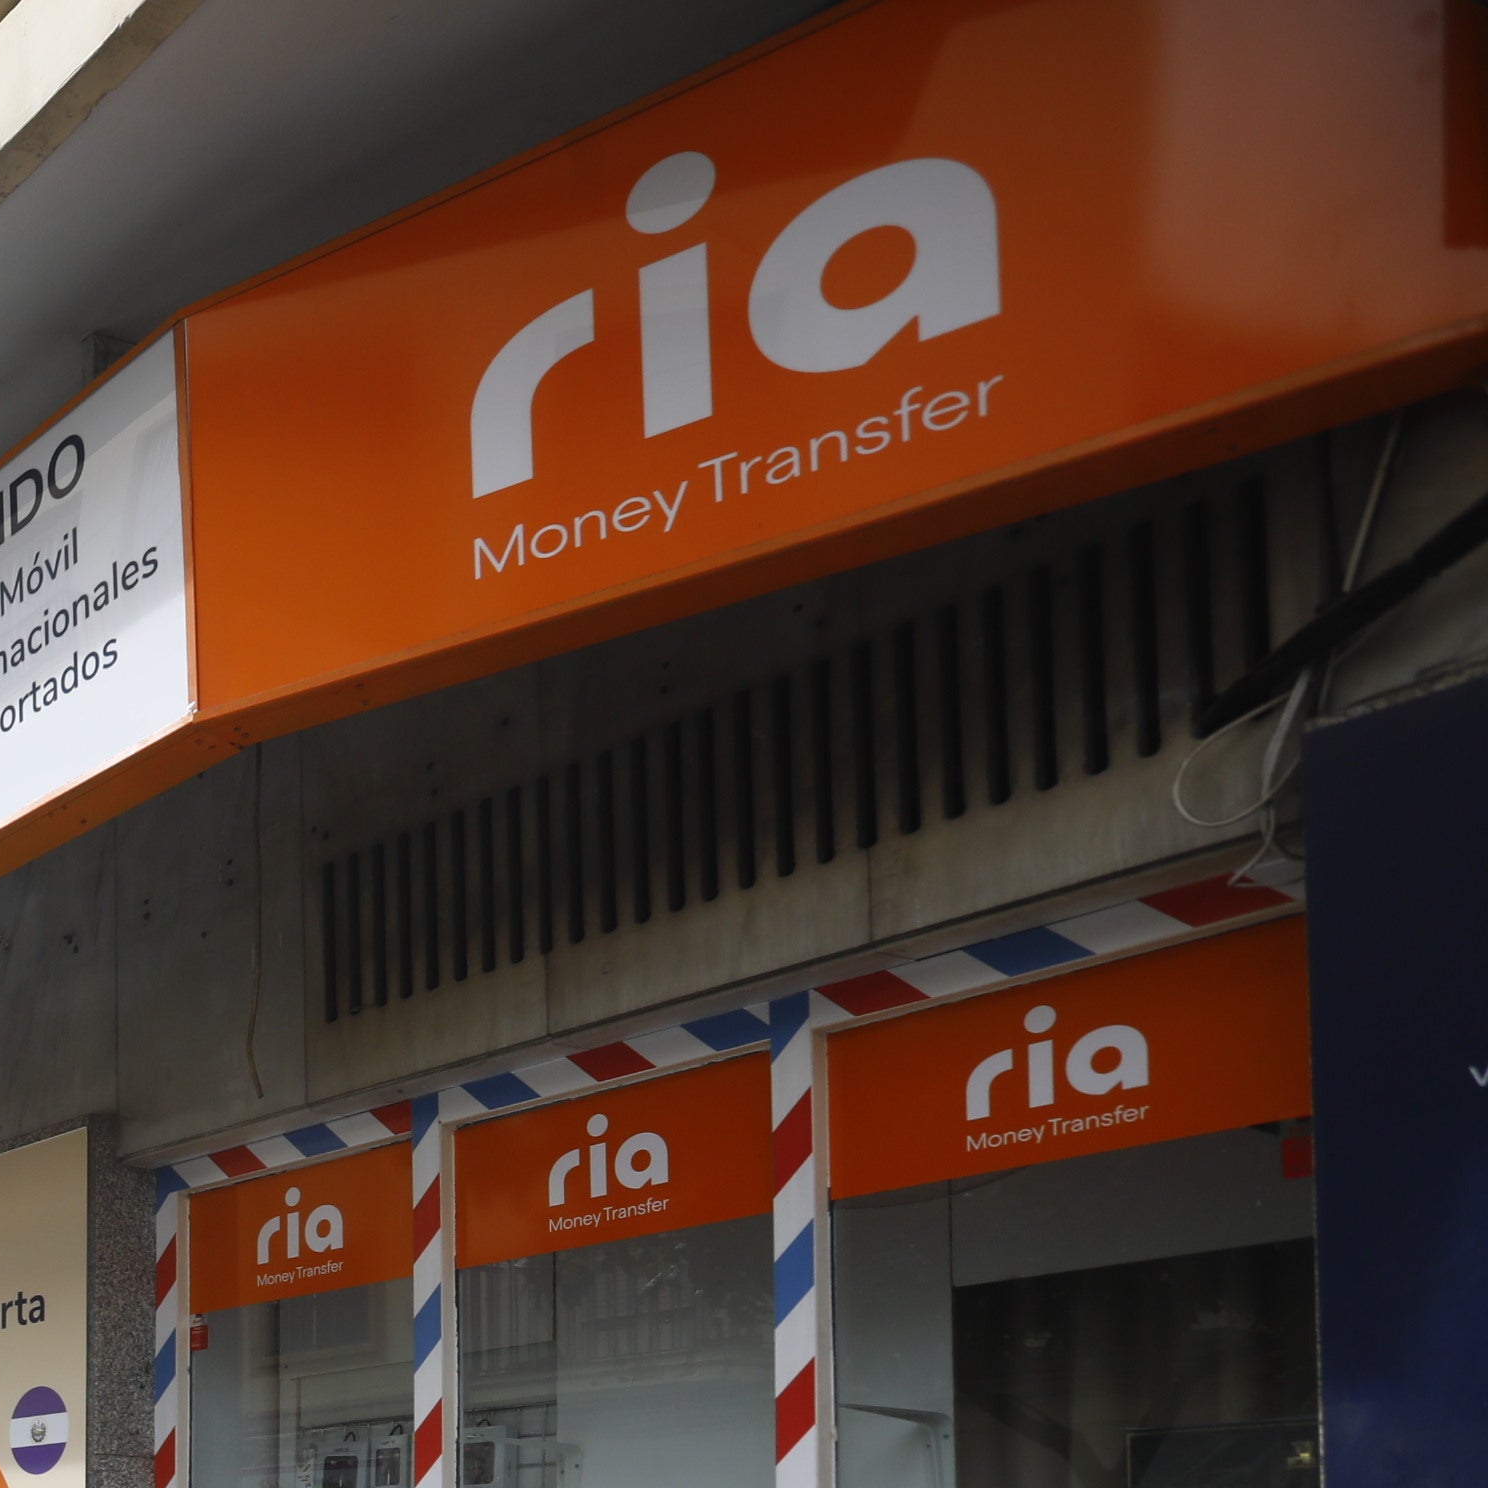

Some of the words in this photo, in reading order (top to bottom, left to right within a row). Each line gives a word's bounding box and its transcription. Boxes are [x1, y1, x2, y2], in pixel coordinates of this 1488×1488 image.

[470, 151, 1001, 500] ria
[473, 480, 687, 581] Money
[698, 375, 1004, 504] Transfer
[0, 527, 79, 617] Móvil
[966, 1005, 1149, 1121] ria
[548, 1113, 669, 1207] ria
[966, 1124, 1044, 1152] Money
[1048, 1103, 1150, 1137] Transfer
[257, 1187, 343, 1264] ria
[549, 1212, 601, 1233] Money
[603, 1196, 670, 1221] Transfer
[257, 1269, 296, 1287] Money
[297, 1259, 343, 1280] Transfer
